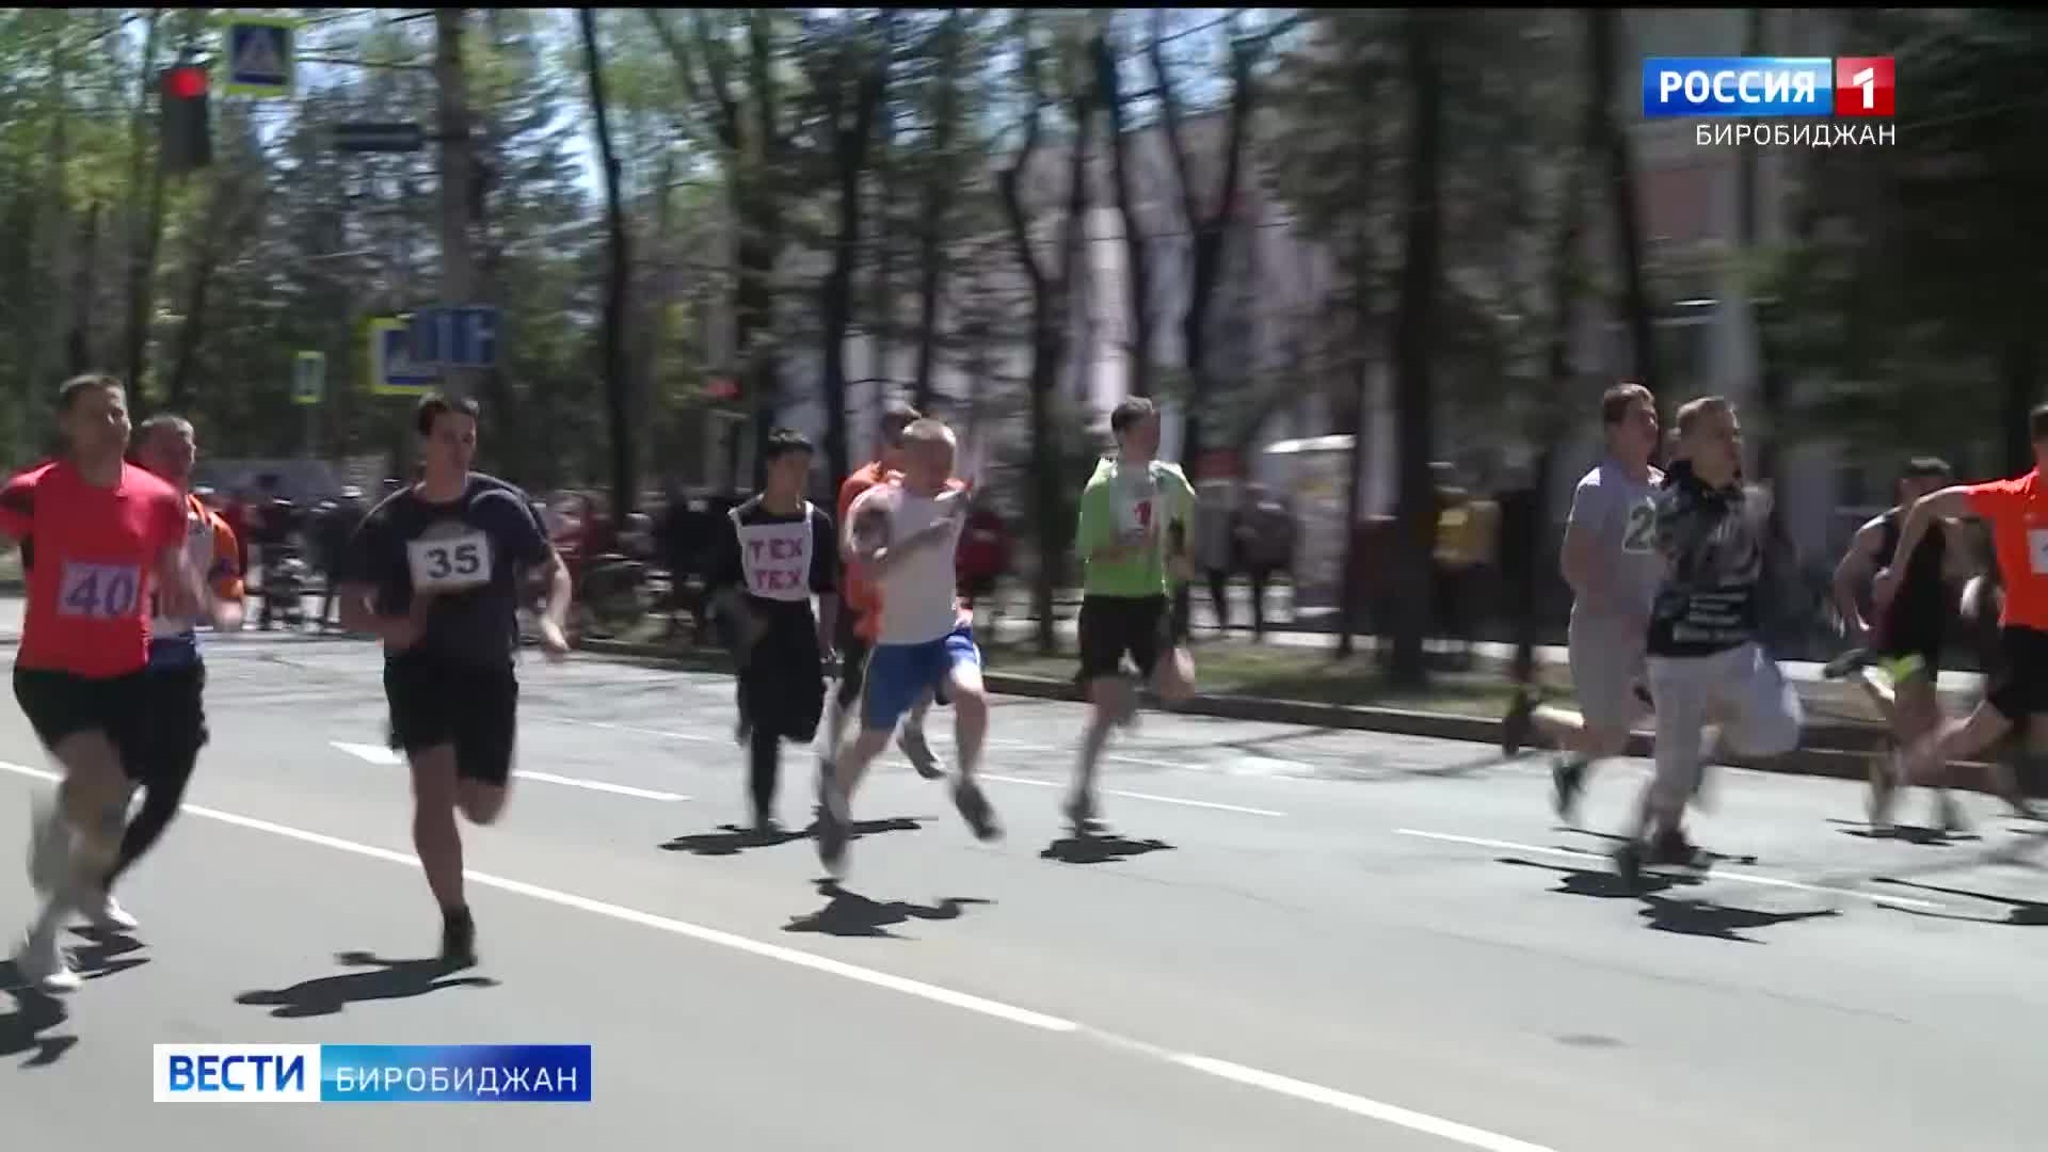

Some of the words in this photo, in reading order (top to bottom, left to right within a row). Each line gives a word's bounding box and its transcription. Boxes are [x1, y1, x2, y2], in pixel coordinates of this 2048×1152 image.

[1622, 504, 1657, 552] 2
[424, 544, 480, 579] 35
[64, 568, 135, 617] 40
